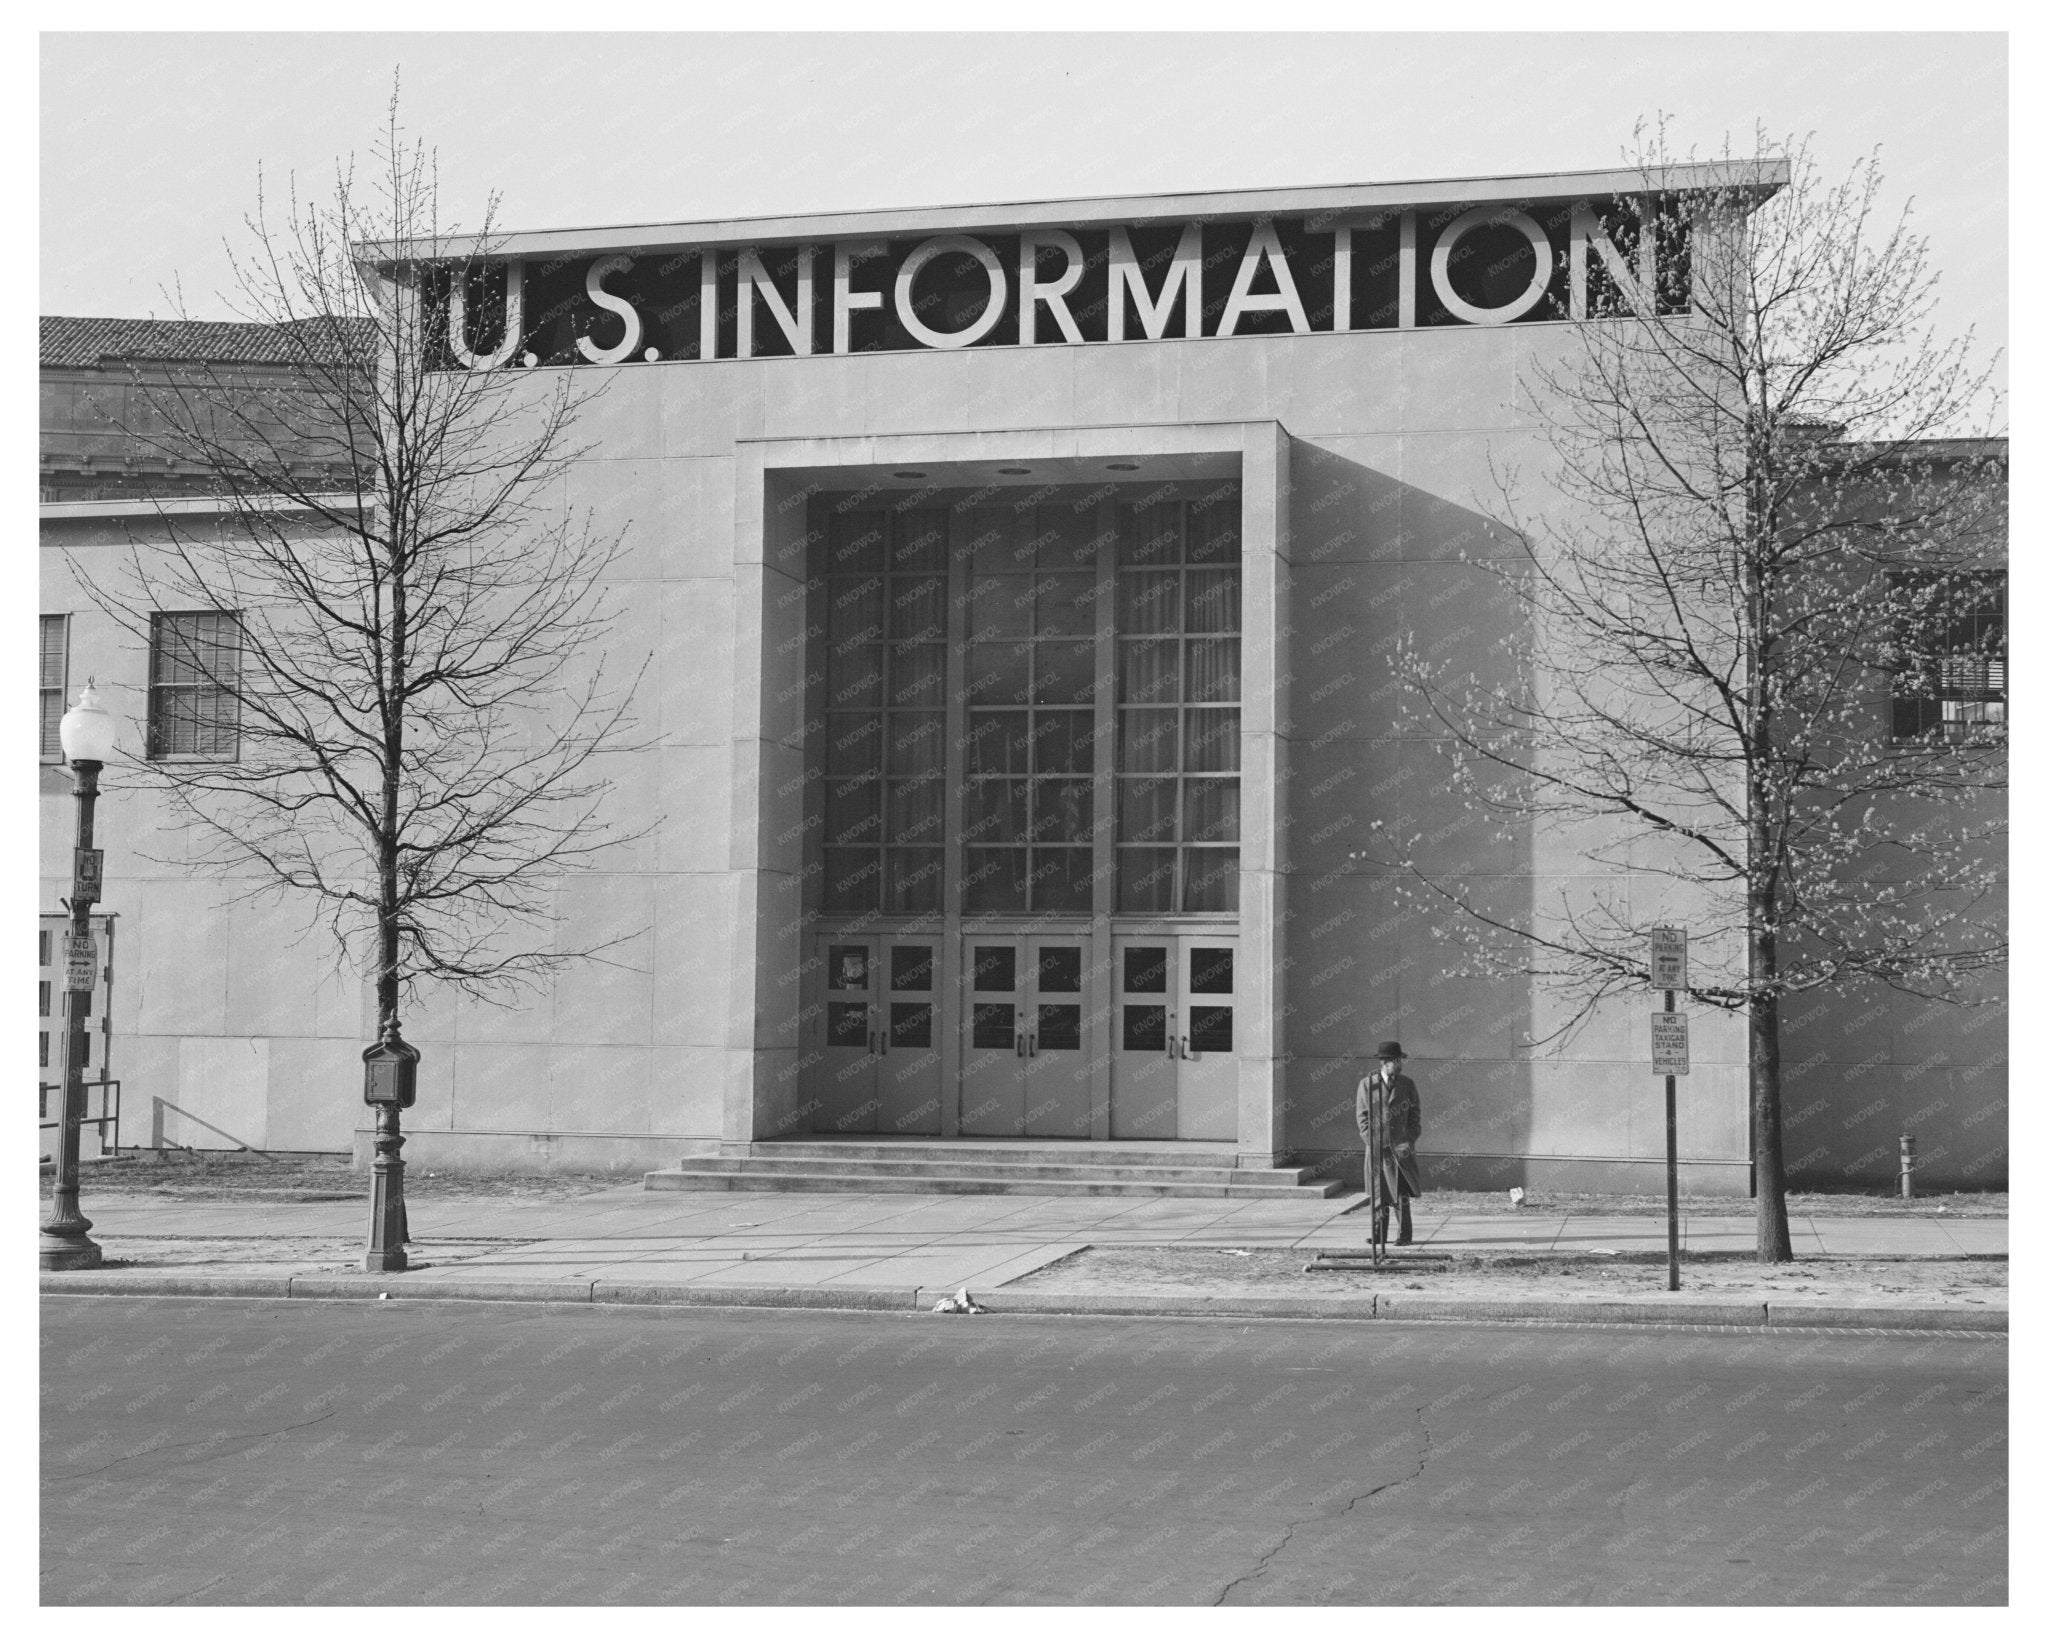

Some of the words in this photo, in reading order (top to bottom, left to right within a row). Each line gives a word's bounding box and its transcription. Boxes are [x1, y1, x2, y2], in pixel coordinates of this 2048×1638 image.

[576, 253, 659, 365] S.
[700, 203, 1656, 359] INFORMATION
[83, 855, 95, 865] NO
[77, 881, 99, 893] TURN
[1662, 932, 1677, 942] NO
[73, 940, 88, 949] NO
[1655, 943, 1684, 954] PARKING
[65, 949, 96, 959] PARKING
[1667, 965, 1680, 973] ANY
[68, 976, 90, 985] TIME
[1663, 1016, 1677, 1024] NO
[1654, 1024, 1686, 1034] PARKING
[1655, 1034, 1685, 1042] TAXICAB
[1655, 1041, 1685, 1049] STAND
[1654, 1057, 1686, 1066] VEHICLES
